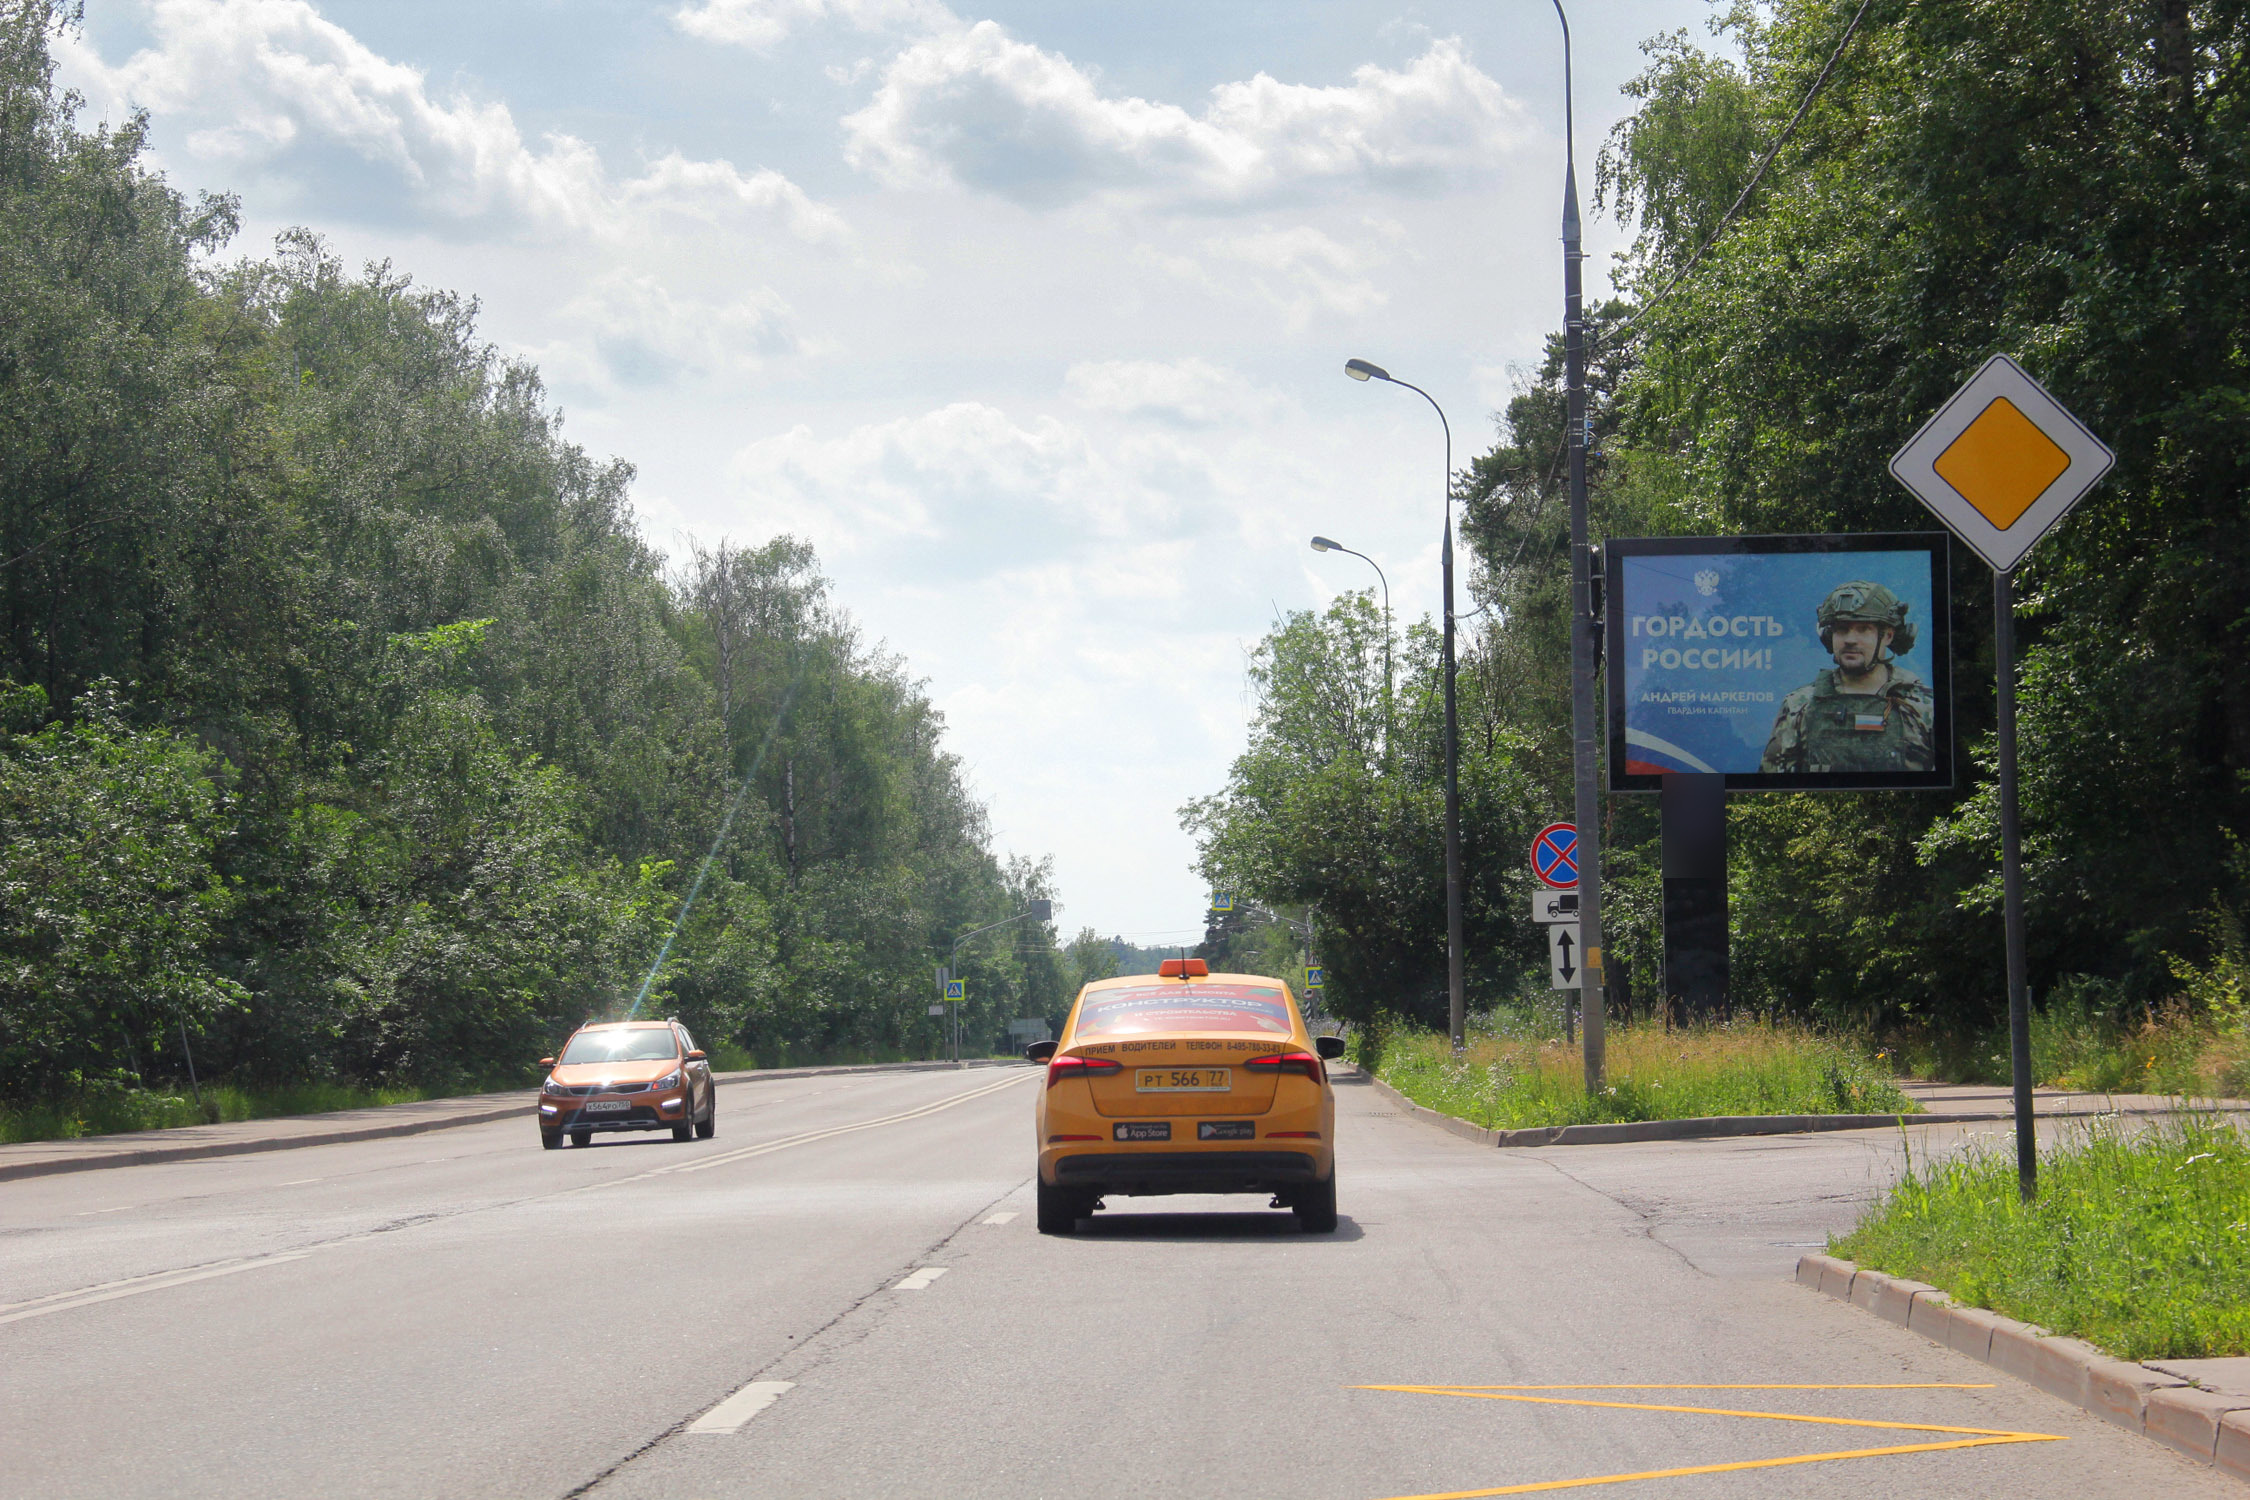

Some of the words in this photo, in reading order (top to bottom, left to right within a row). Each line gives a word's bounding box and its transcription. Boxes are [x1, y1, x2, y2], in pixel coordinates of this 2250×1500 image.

[1632, 615, 1783, 640] ГОРДОСТЬ
[1642, 648, 1772, 670] РОССИИ!
[1641, 689, 1696, 703] АНДРЕЙ
[1700, 691, 1774, 702] МАРКЕЛОВ
[1667, 706, 1706, 715] ГВАРДИИ
[1708, 706, 1748, 714] КАПИТАН
[1097, 997, 1263, 1013] КОНСТРУКТОР
[1085, 1045, 1116, 1056] ПРИЕМ
[1121, 1041, 1176, 1052] ВОДИТЕЛЕЙ
[1186, 1041, 1222, 1050] ТЕЛЕФОН
[1170, 1071, 1200, 1087] 566
[1209, 1070, 1224, 1083] 77
[1130, 1128, 1147, 1139] App
[1147, 1127, 1168, 1137] Store
